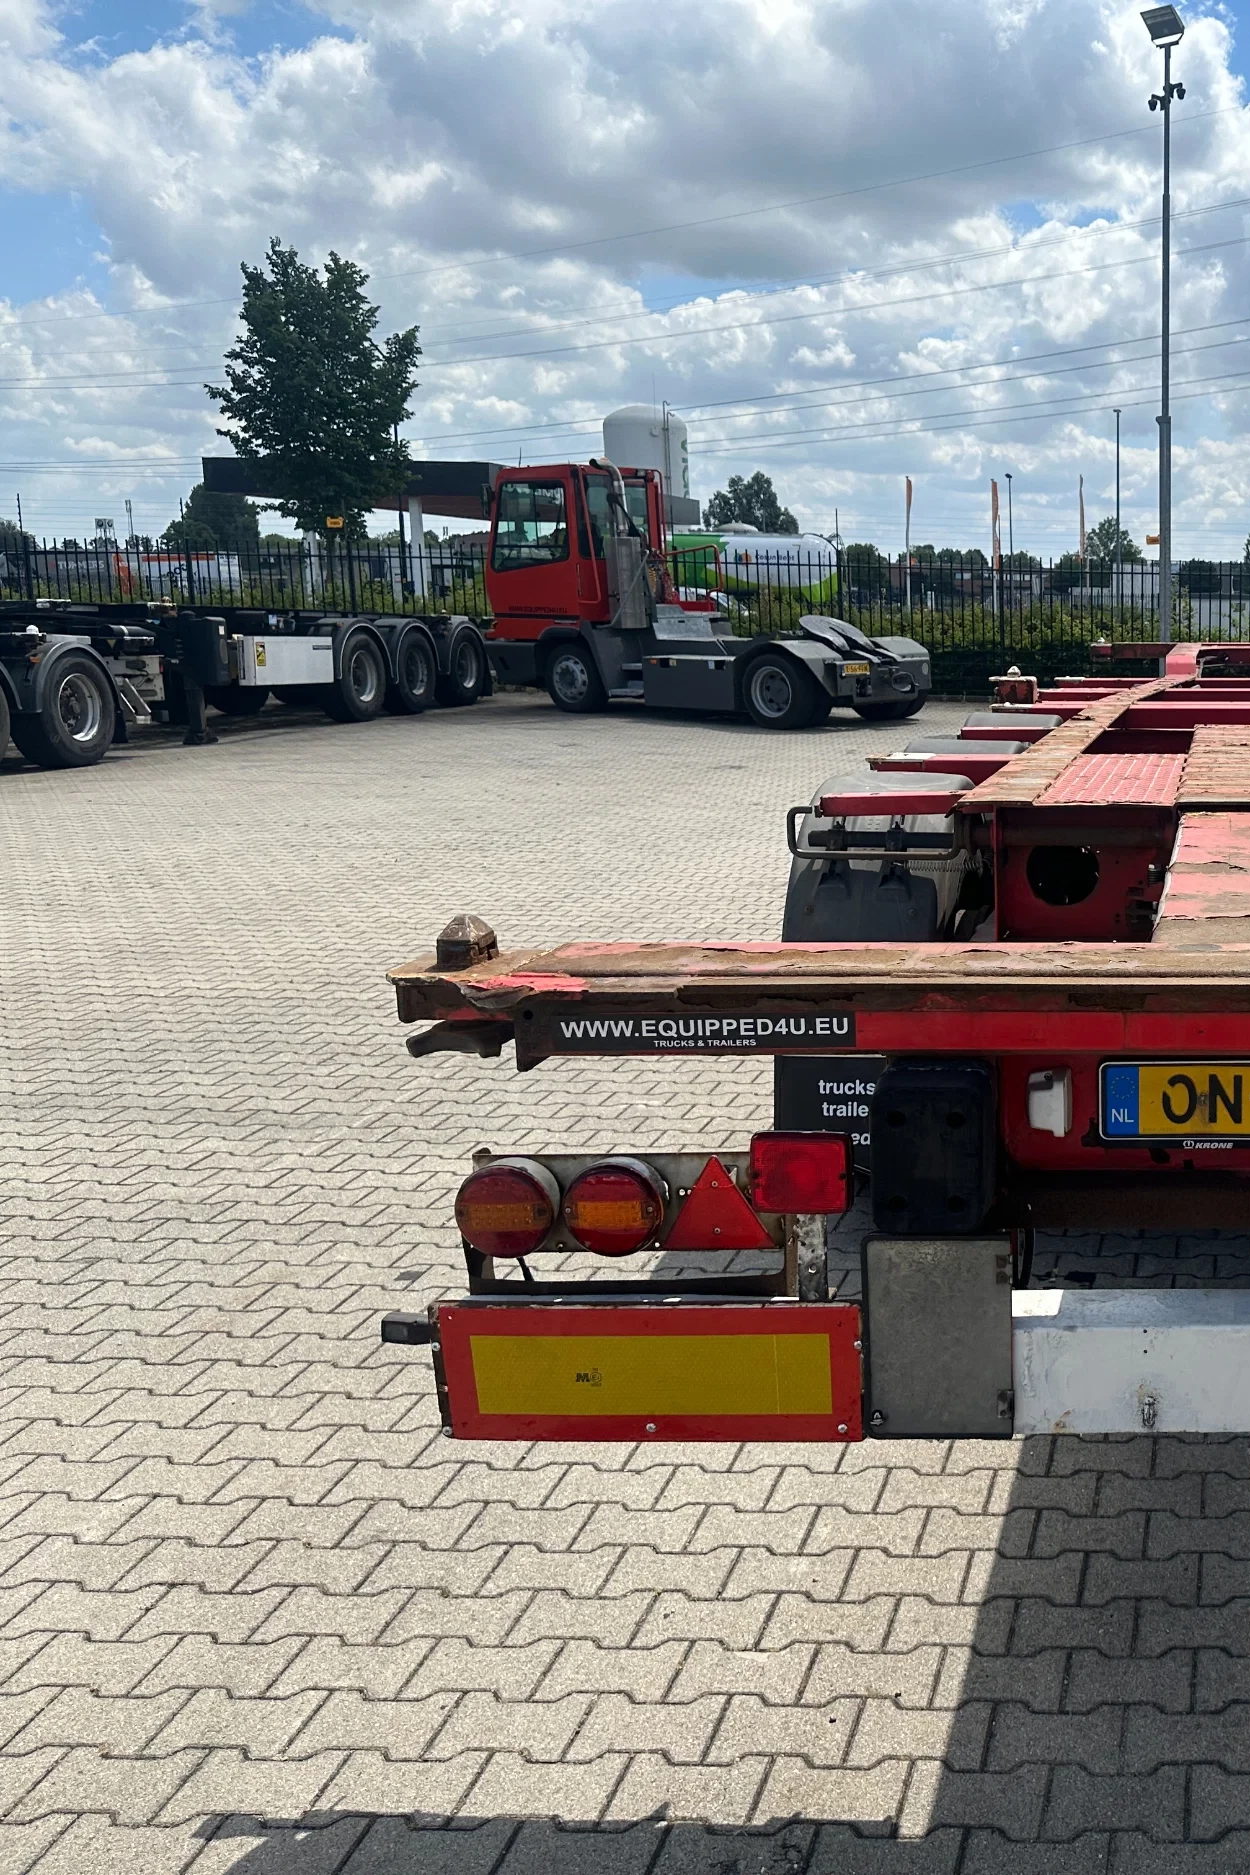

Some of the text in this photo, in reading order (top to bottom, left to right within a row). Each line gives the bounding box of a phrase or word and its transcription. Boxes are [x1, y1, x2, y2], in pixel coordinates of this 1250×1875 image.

[560, 1017, 849, 1038] WWW.EQUIPPED4U.EU
[653, 1038, 757, 1048] TRUCKS & TRAILERS
[818, 1079, 876, 1095] trucks
[822, 1101, 869, 1117] traile
[1111, 1108, 1135, 1123] NL
